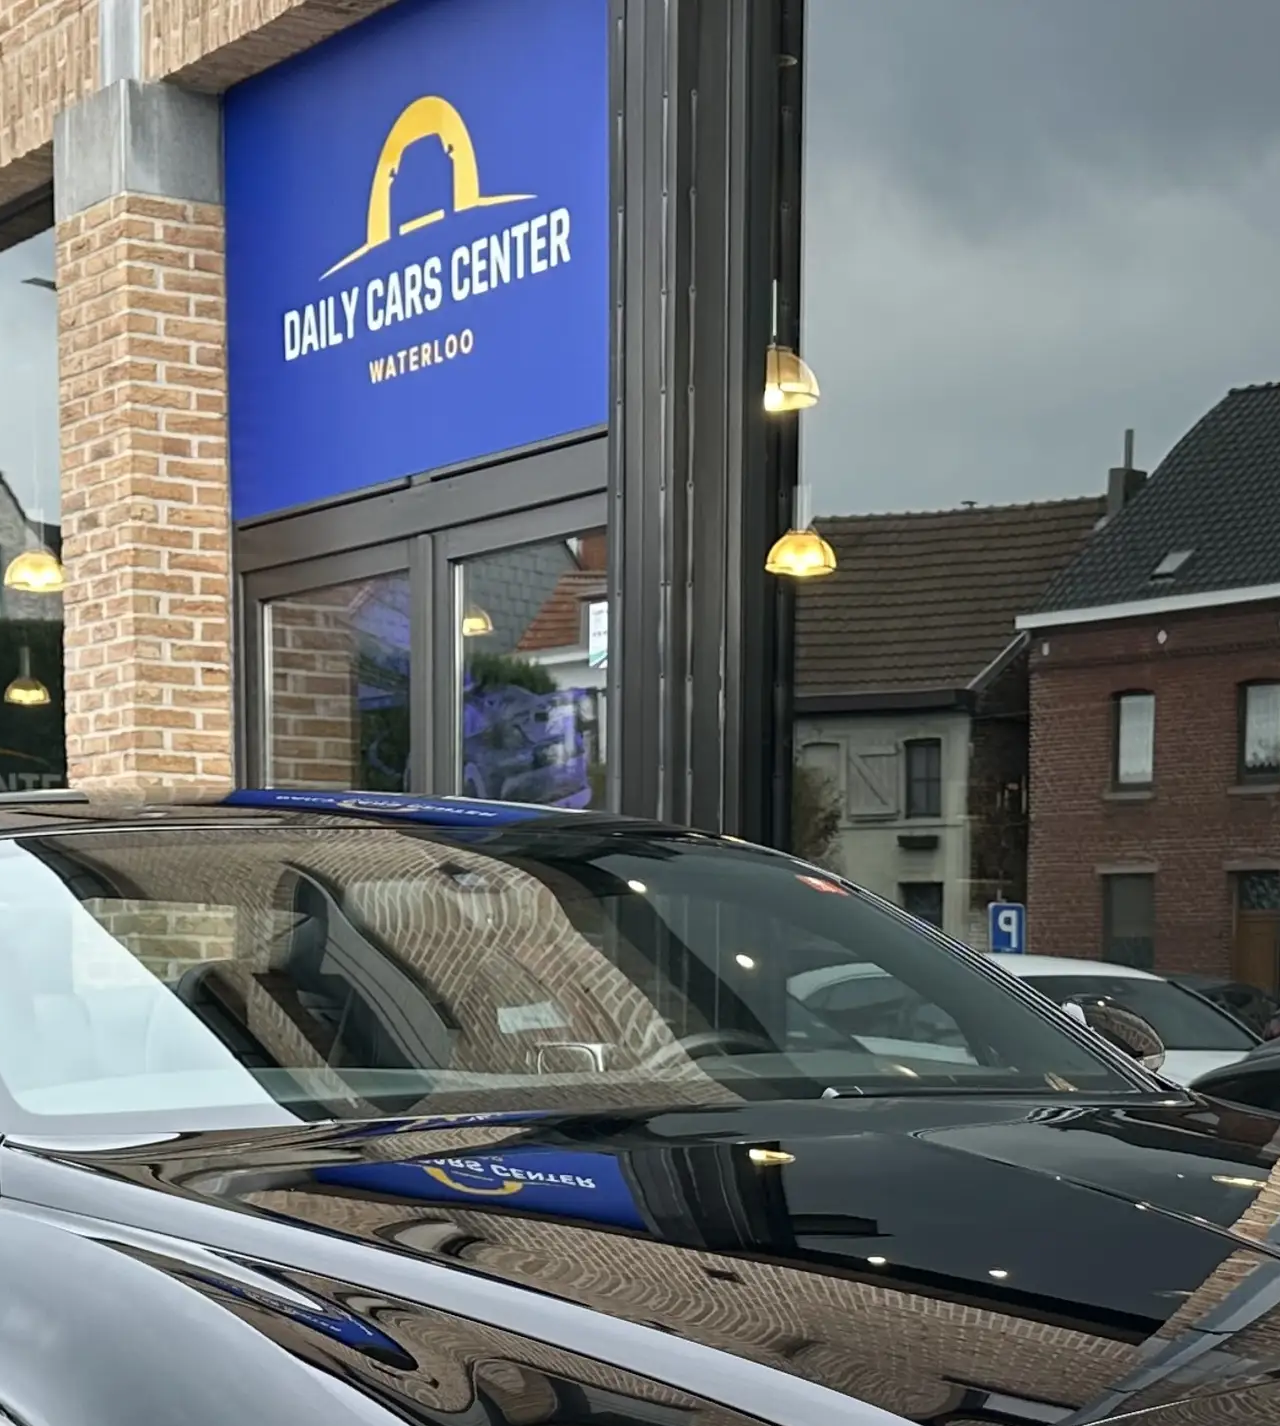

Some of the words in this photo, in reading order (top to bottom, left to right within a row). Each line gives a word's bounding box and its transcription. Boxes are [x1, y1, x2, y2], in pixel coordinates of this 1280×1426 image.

[284, 287, 359, 361] DAILY
[366, 256, 442, 331] CARS
[451, 207, 571, 302] CENTER
[369, 328, 474, 384] WATERLOO
